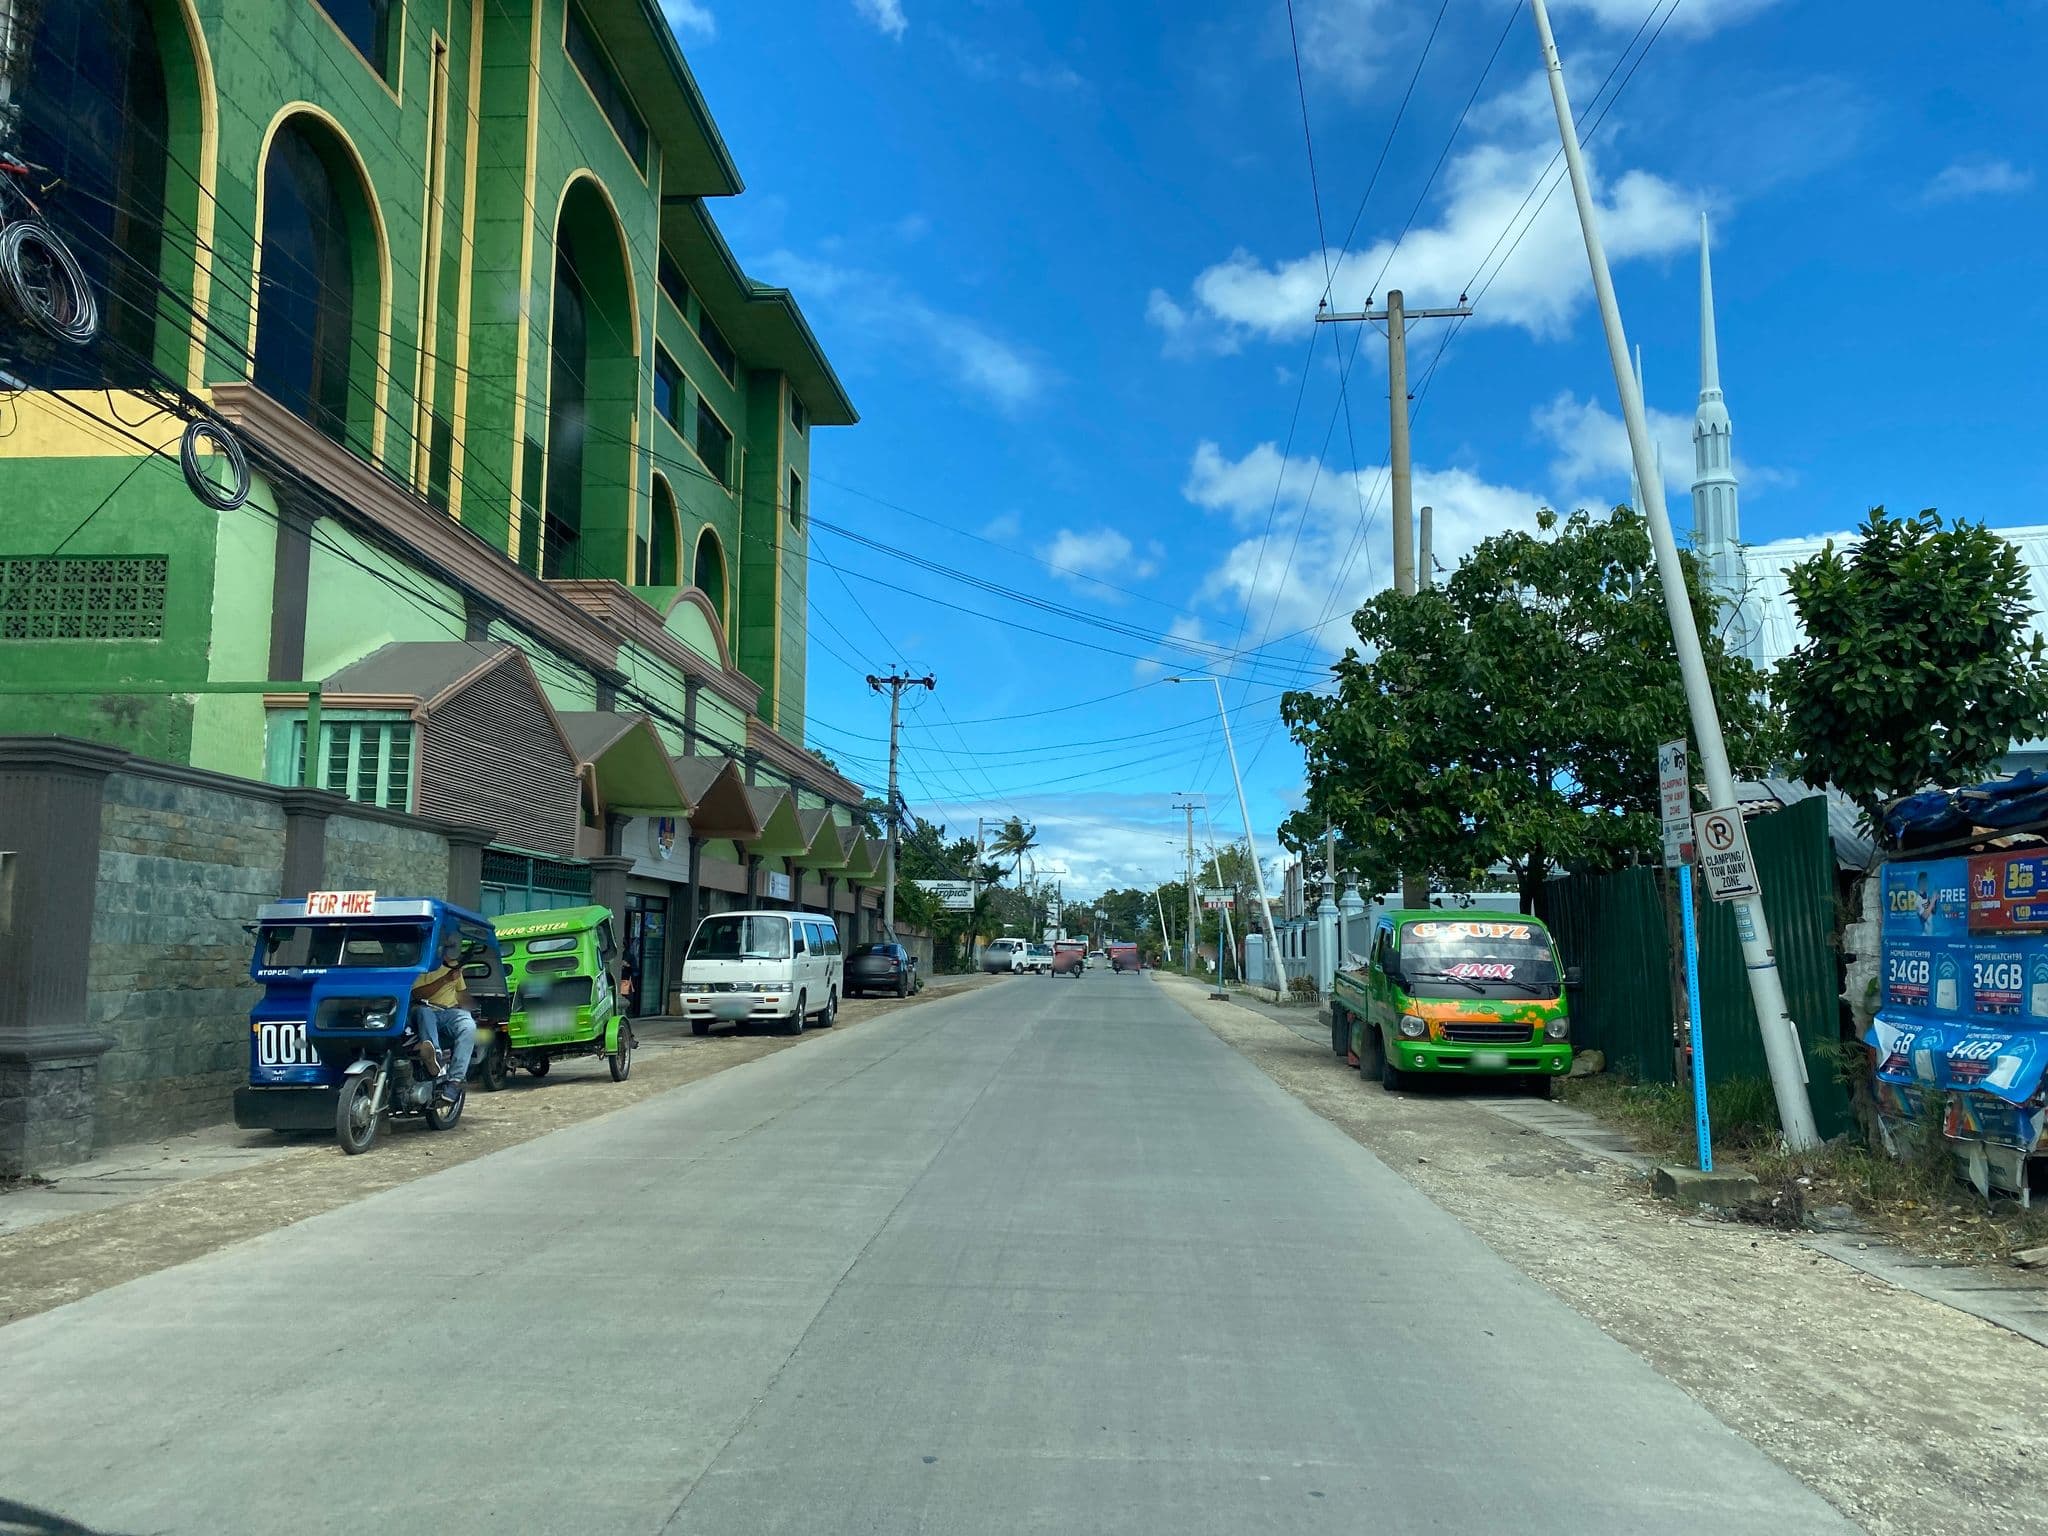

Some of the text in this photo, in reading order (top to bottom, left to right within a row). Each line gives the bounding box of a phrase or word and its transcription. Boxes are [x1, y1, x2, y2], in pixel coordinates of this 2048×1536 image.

[1705, 850, 1745, 867] CLAMPING/
[1710, 862, 1747, 878] TOW AWAY
[1721, 875, 1741, 888] ZONE
[307, 893, 374, 915] FOR HIRE
[1888, 888, 1967, 912] 2GB FREE
[527, 921, 569, 934] SYSTEM
[1888, 959, 1930, 984] 34GB
[1973, 963, 2023, 990] 34GB
[1946, 1040, 2003, 1060] 34GB
